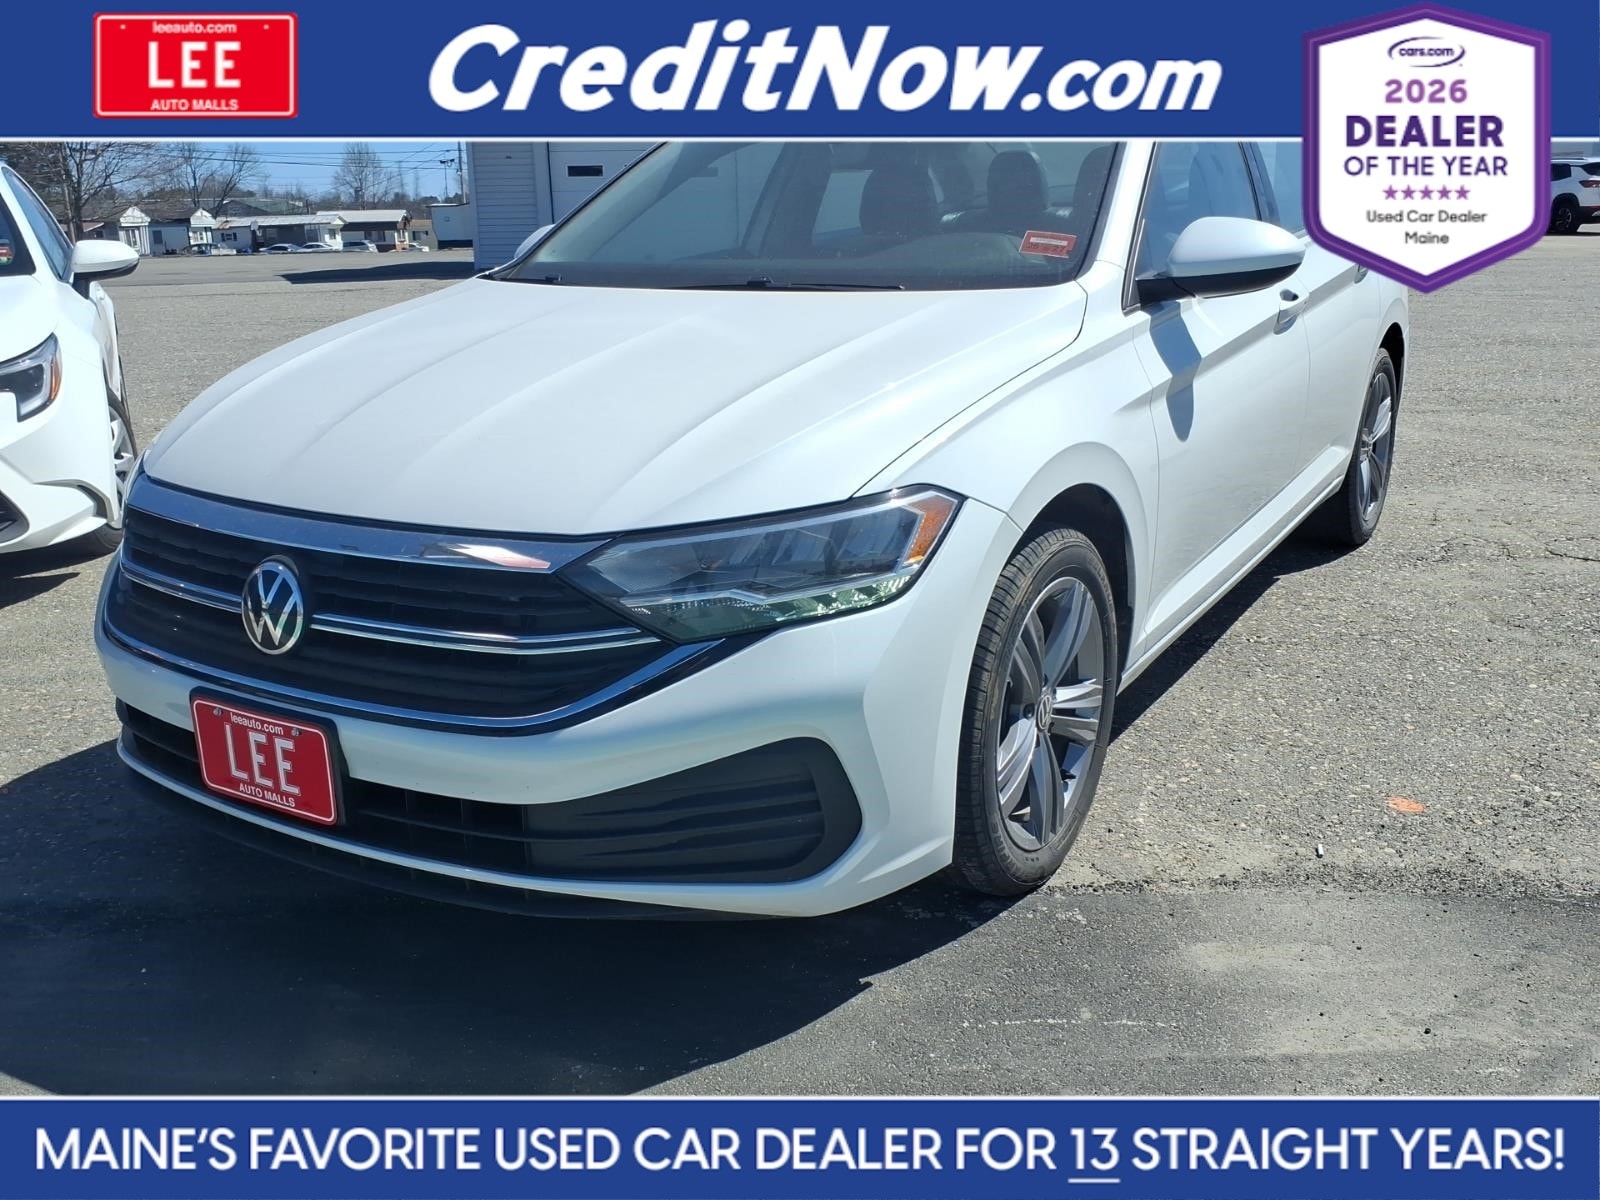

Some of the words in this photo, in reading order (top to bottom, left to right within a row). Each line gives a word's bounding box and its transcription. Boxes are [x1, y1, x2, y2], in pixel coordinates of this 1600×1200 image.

[230, 712, 284, 735] leeauto.com
[224, 722, 301, 796] LEE
[239, 782, 264, 798] AUTO
[264, 789, 296, 808] MALLS
